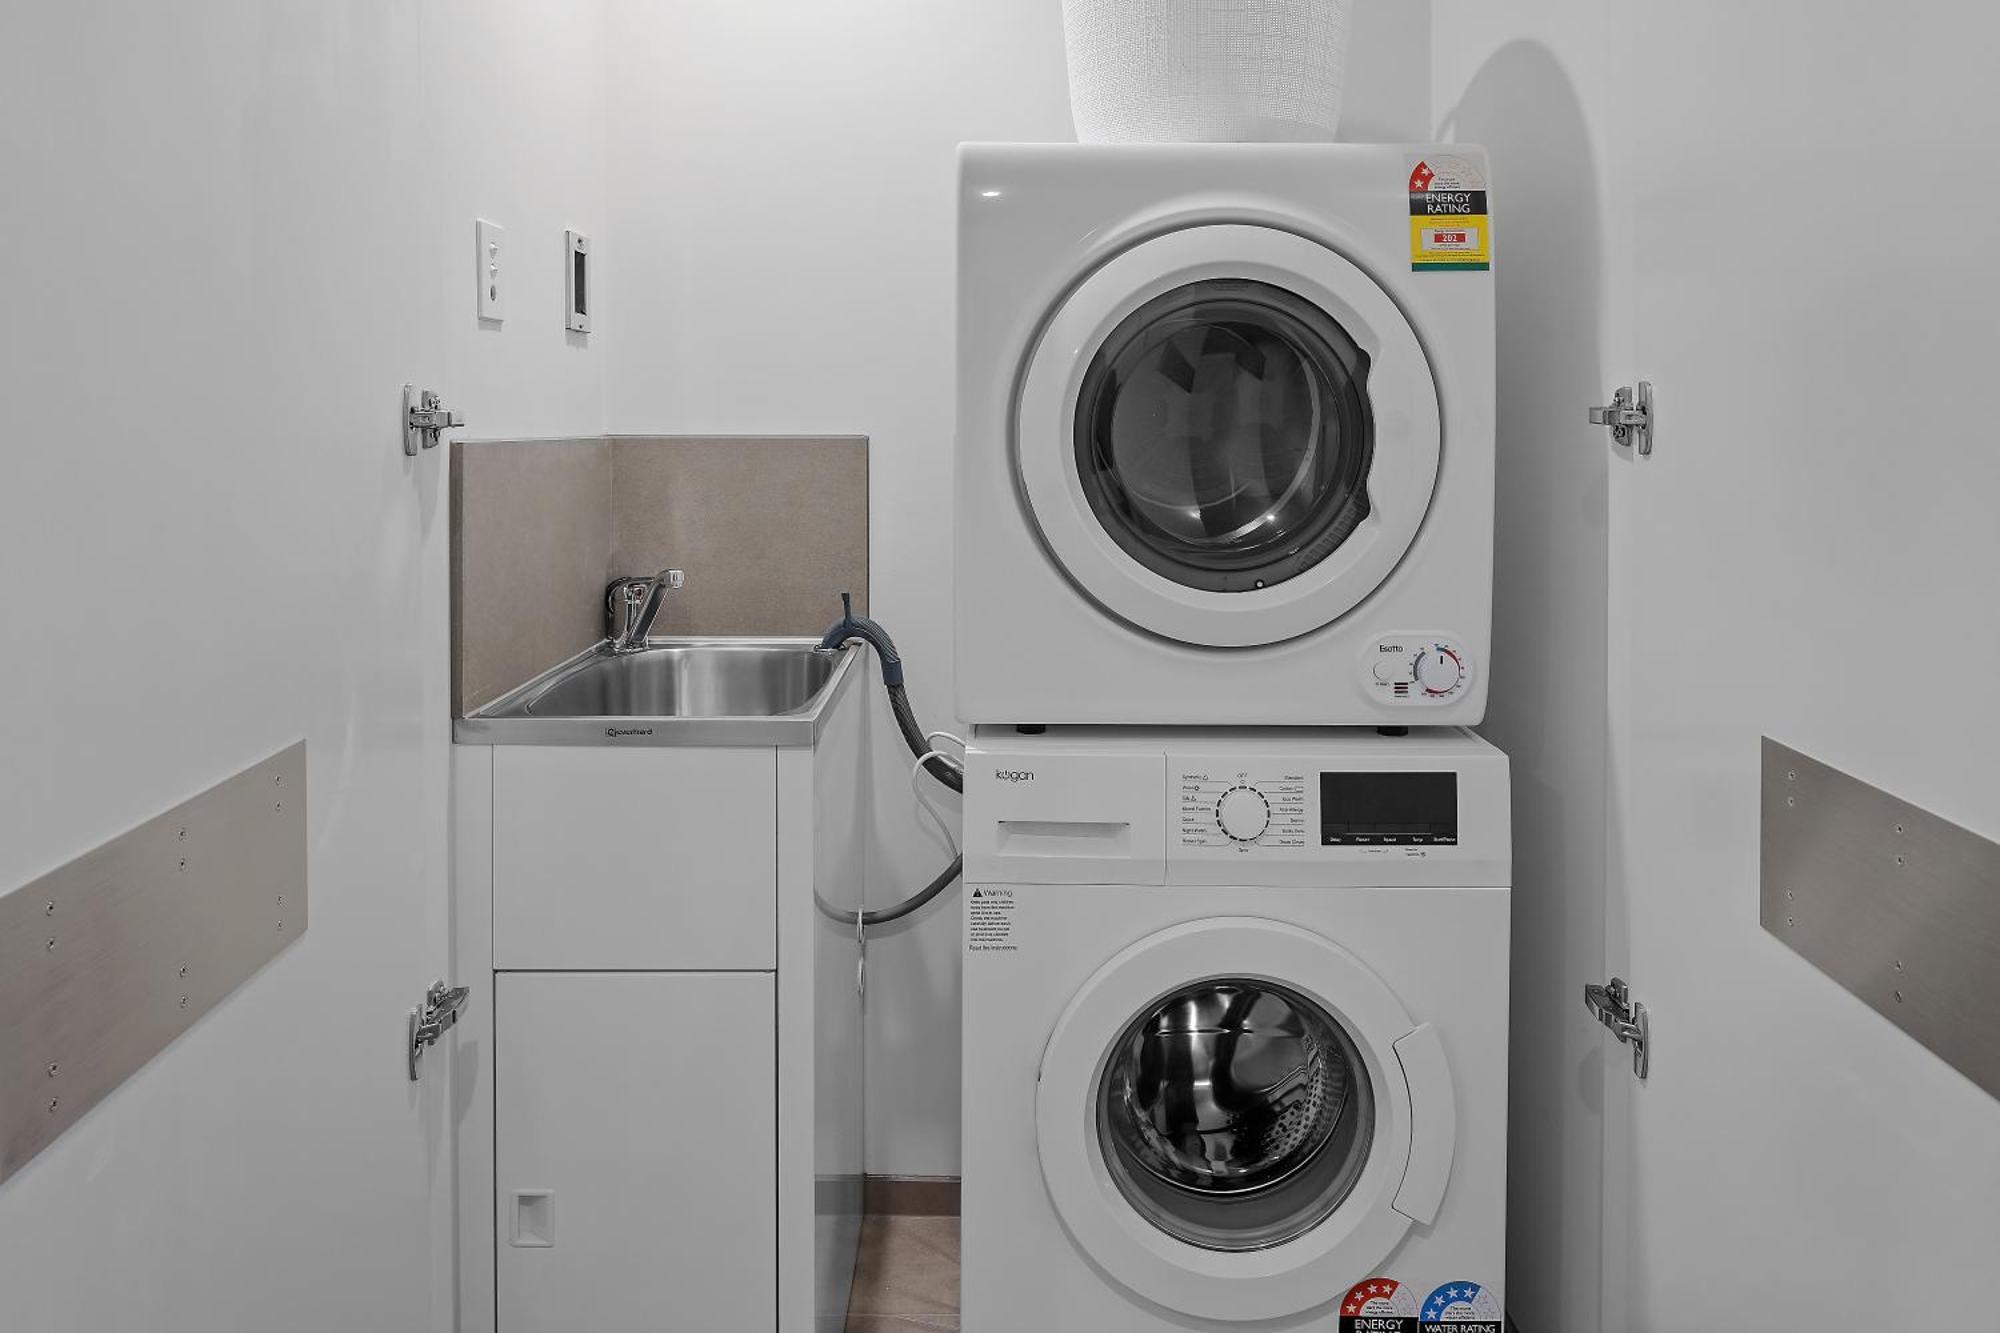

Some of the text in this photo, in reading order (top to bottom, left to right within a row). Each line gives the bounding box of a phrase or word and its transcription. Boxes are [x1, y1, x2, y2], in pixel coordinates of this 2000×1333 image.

[1425, 192, 1472, 203] ENERGY
[1427, 203, 1471, 214] RATING
[1379, 645, 1404, 653] Esotto
[1354, 1319, 1404, 1330] ENERGY
[1424, 1324, 1496, 1333] WATER RATING
